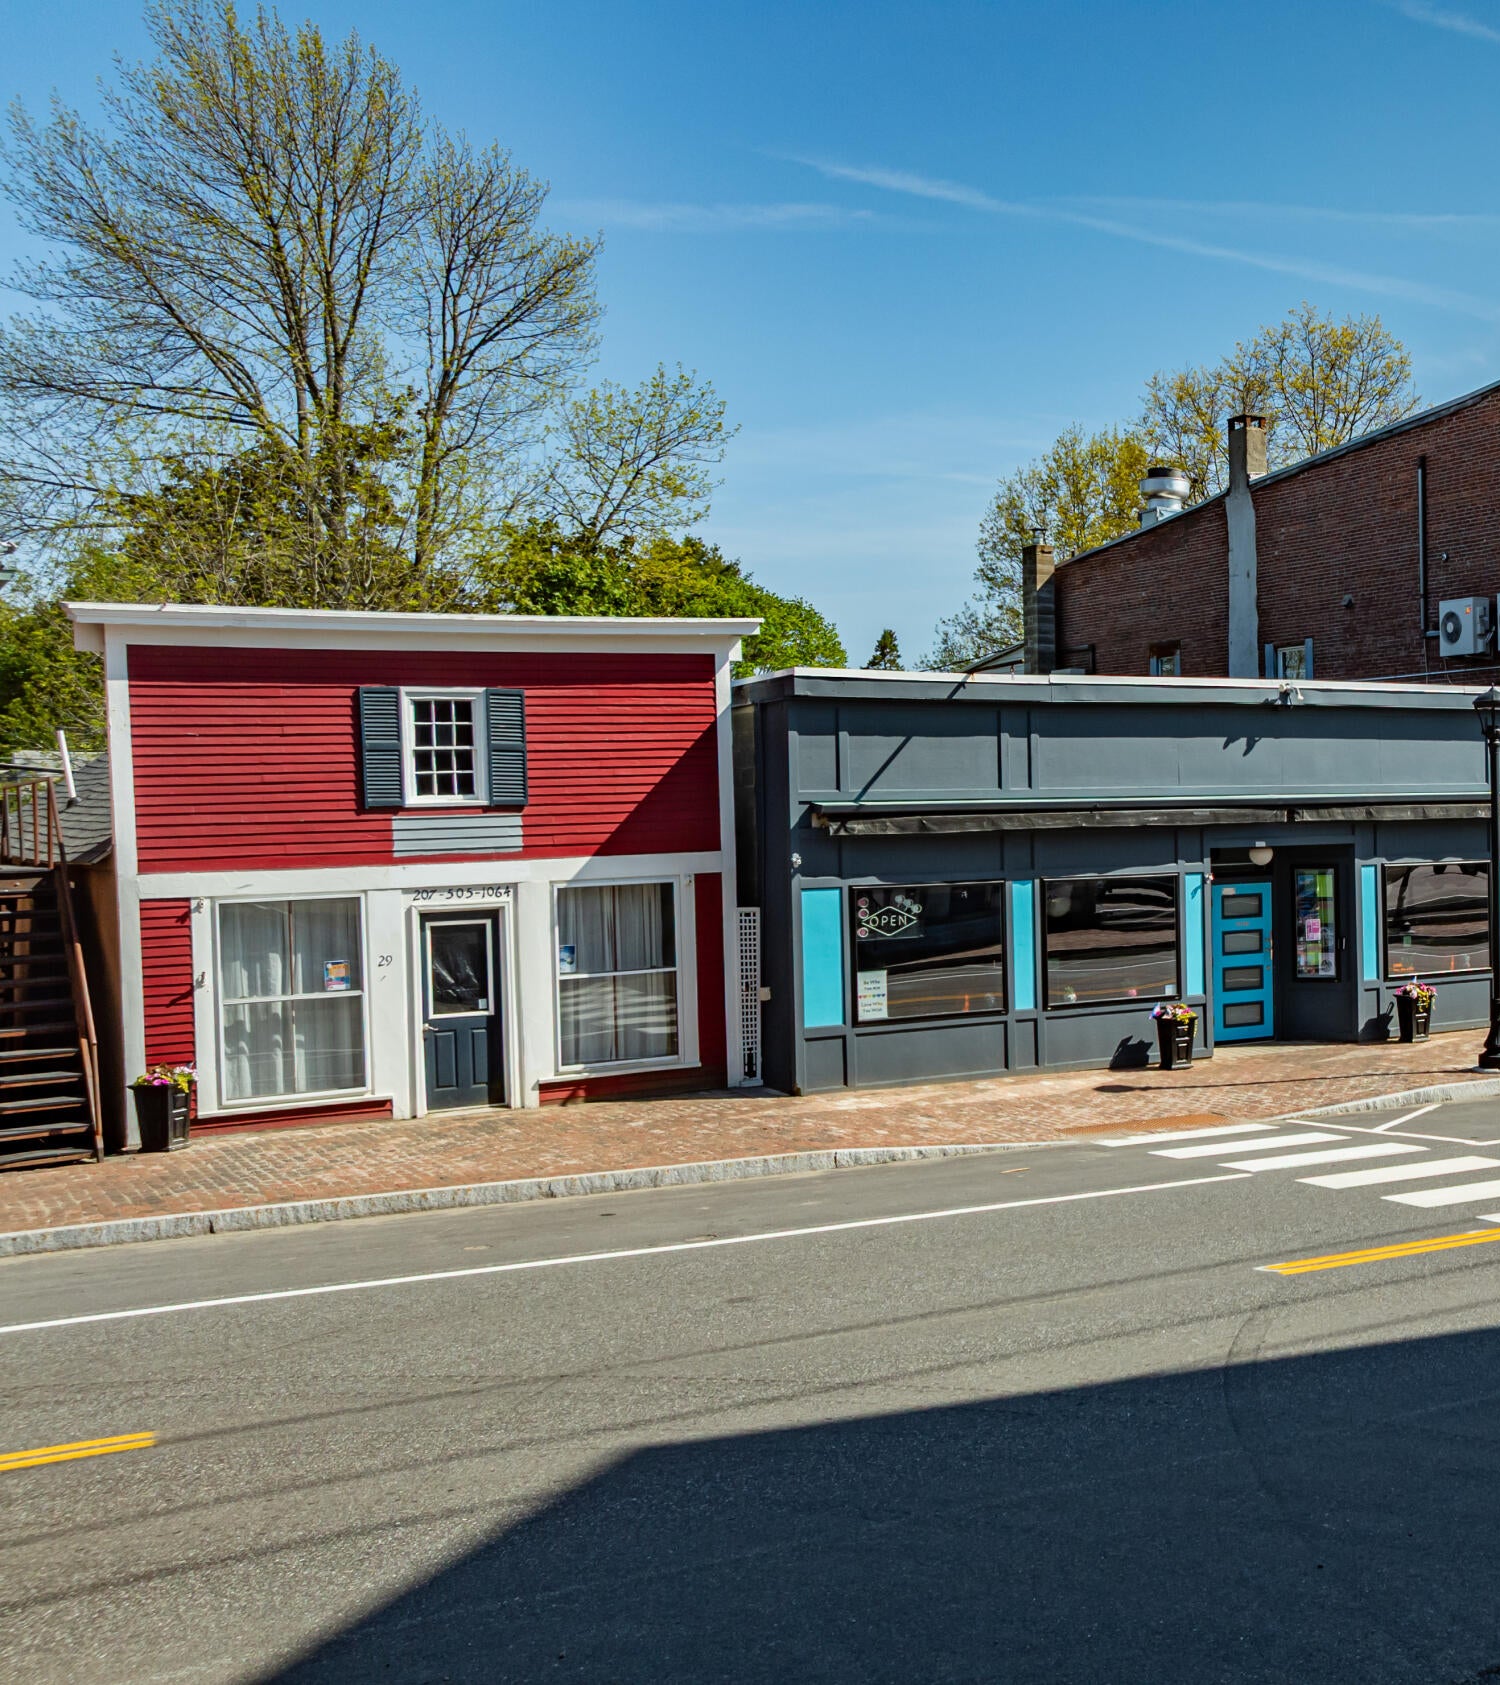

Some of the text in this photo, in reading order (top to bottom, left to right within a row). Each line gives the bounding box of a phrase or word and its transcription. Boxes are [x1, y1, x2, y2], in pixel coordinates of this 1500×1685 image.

[412, 885, 512, 901] 207-505-1064
[869, 914, 907, 927] OPEN
[377, 954, 393, 968] 29
